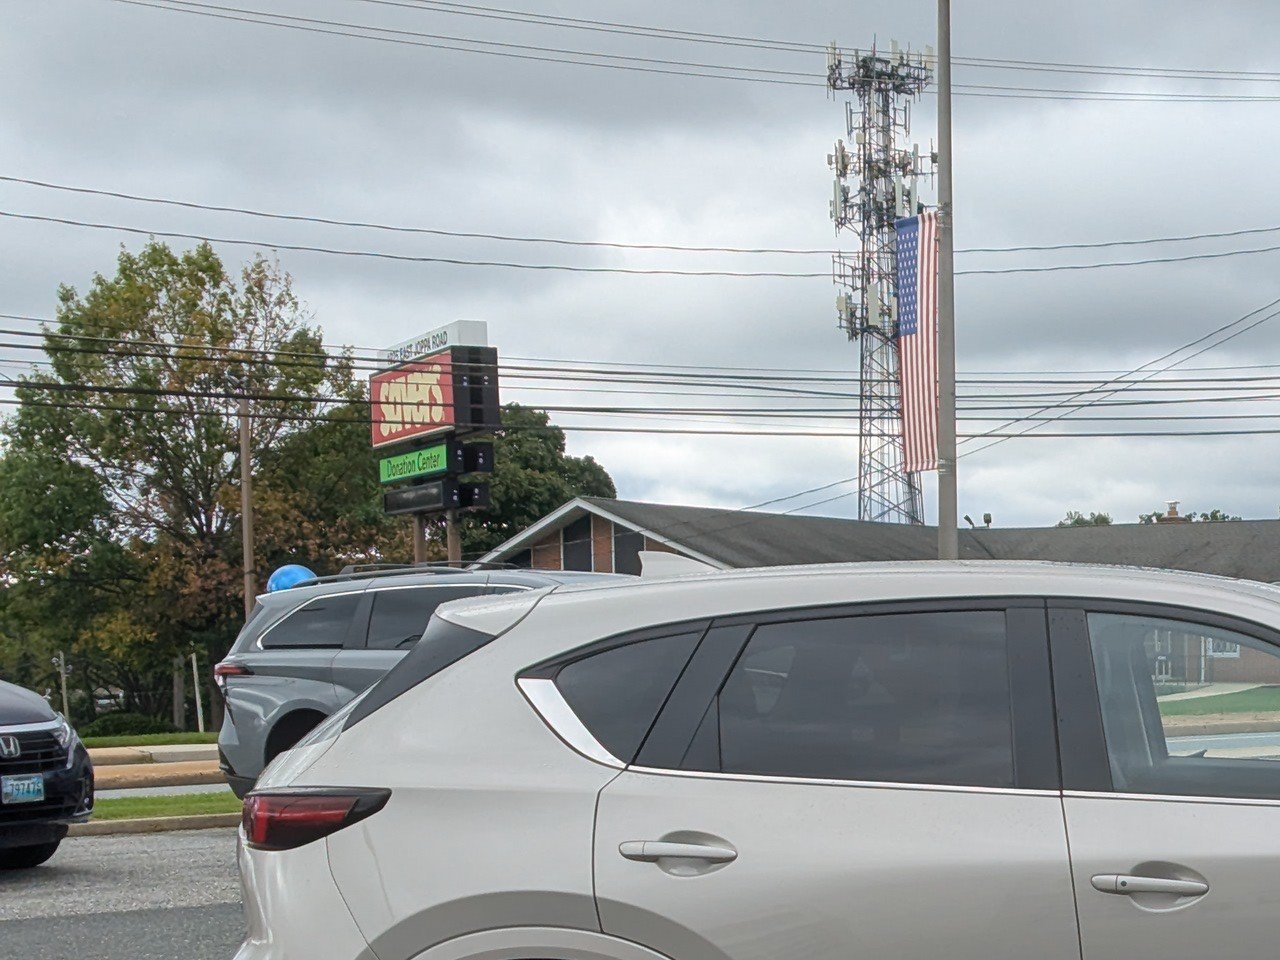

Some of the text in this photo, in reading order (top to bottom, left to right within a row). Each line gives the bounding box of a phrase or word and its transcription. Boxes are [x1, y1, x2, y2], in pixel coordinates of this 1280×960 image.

[432, 331, 448, 349] ROAD
[386, 451, 440, 478] Donation Center
